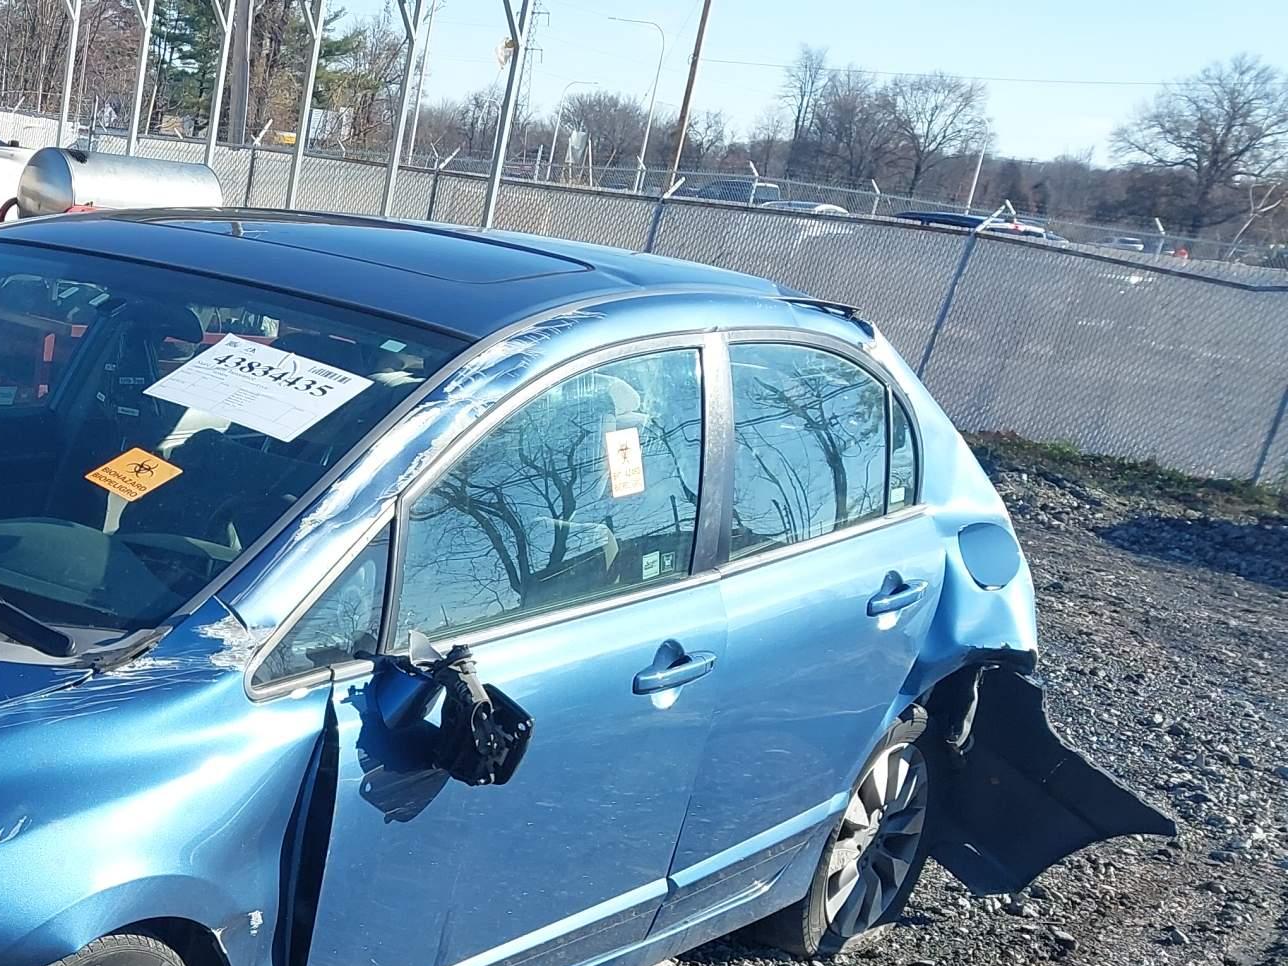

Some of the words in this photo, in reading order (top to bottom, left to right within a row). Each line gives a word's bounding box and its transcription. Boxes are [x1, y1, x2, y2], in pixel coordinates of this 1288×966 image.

[213, 354, 335, 398] 43834435
[92, 472, 138, 498] BIOPELIGRO
[101, 466, 148, 493] BIOHAZARD
